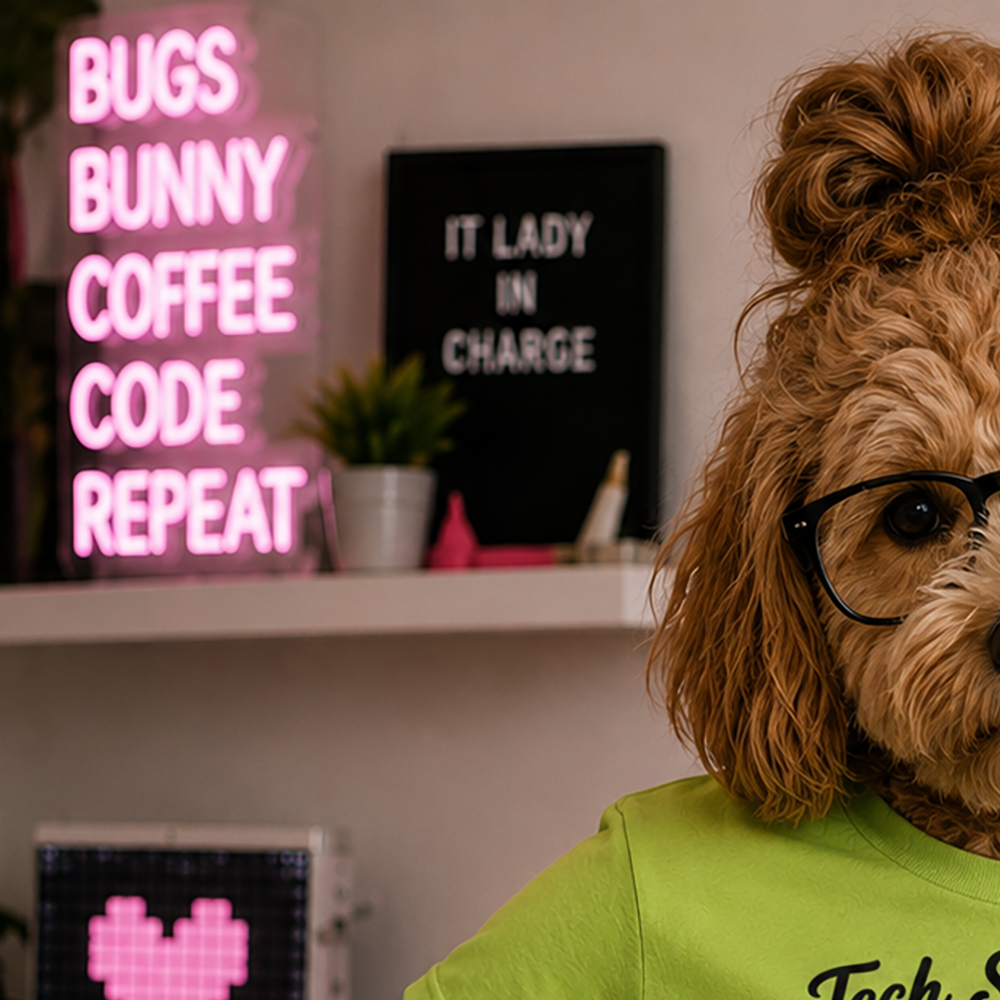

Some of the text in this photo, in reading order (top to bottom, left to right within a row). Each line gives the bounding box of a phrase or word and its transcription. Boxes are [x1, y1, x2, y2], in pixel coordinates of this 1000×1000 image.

[69, 26, 239, 124] BUGS
[69, 135, 289, 233] BUNNY
[444, 211, 593, 260] IT LADY
[68, 245, 297, 342] COFFEE
[496, 270, 537, 315] IN
[442, 326, 596, 375] CHARGE
[69, 358, 245, 450] CODE
[73, 466, 307, 558] REPEAT
